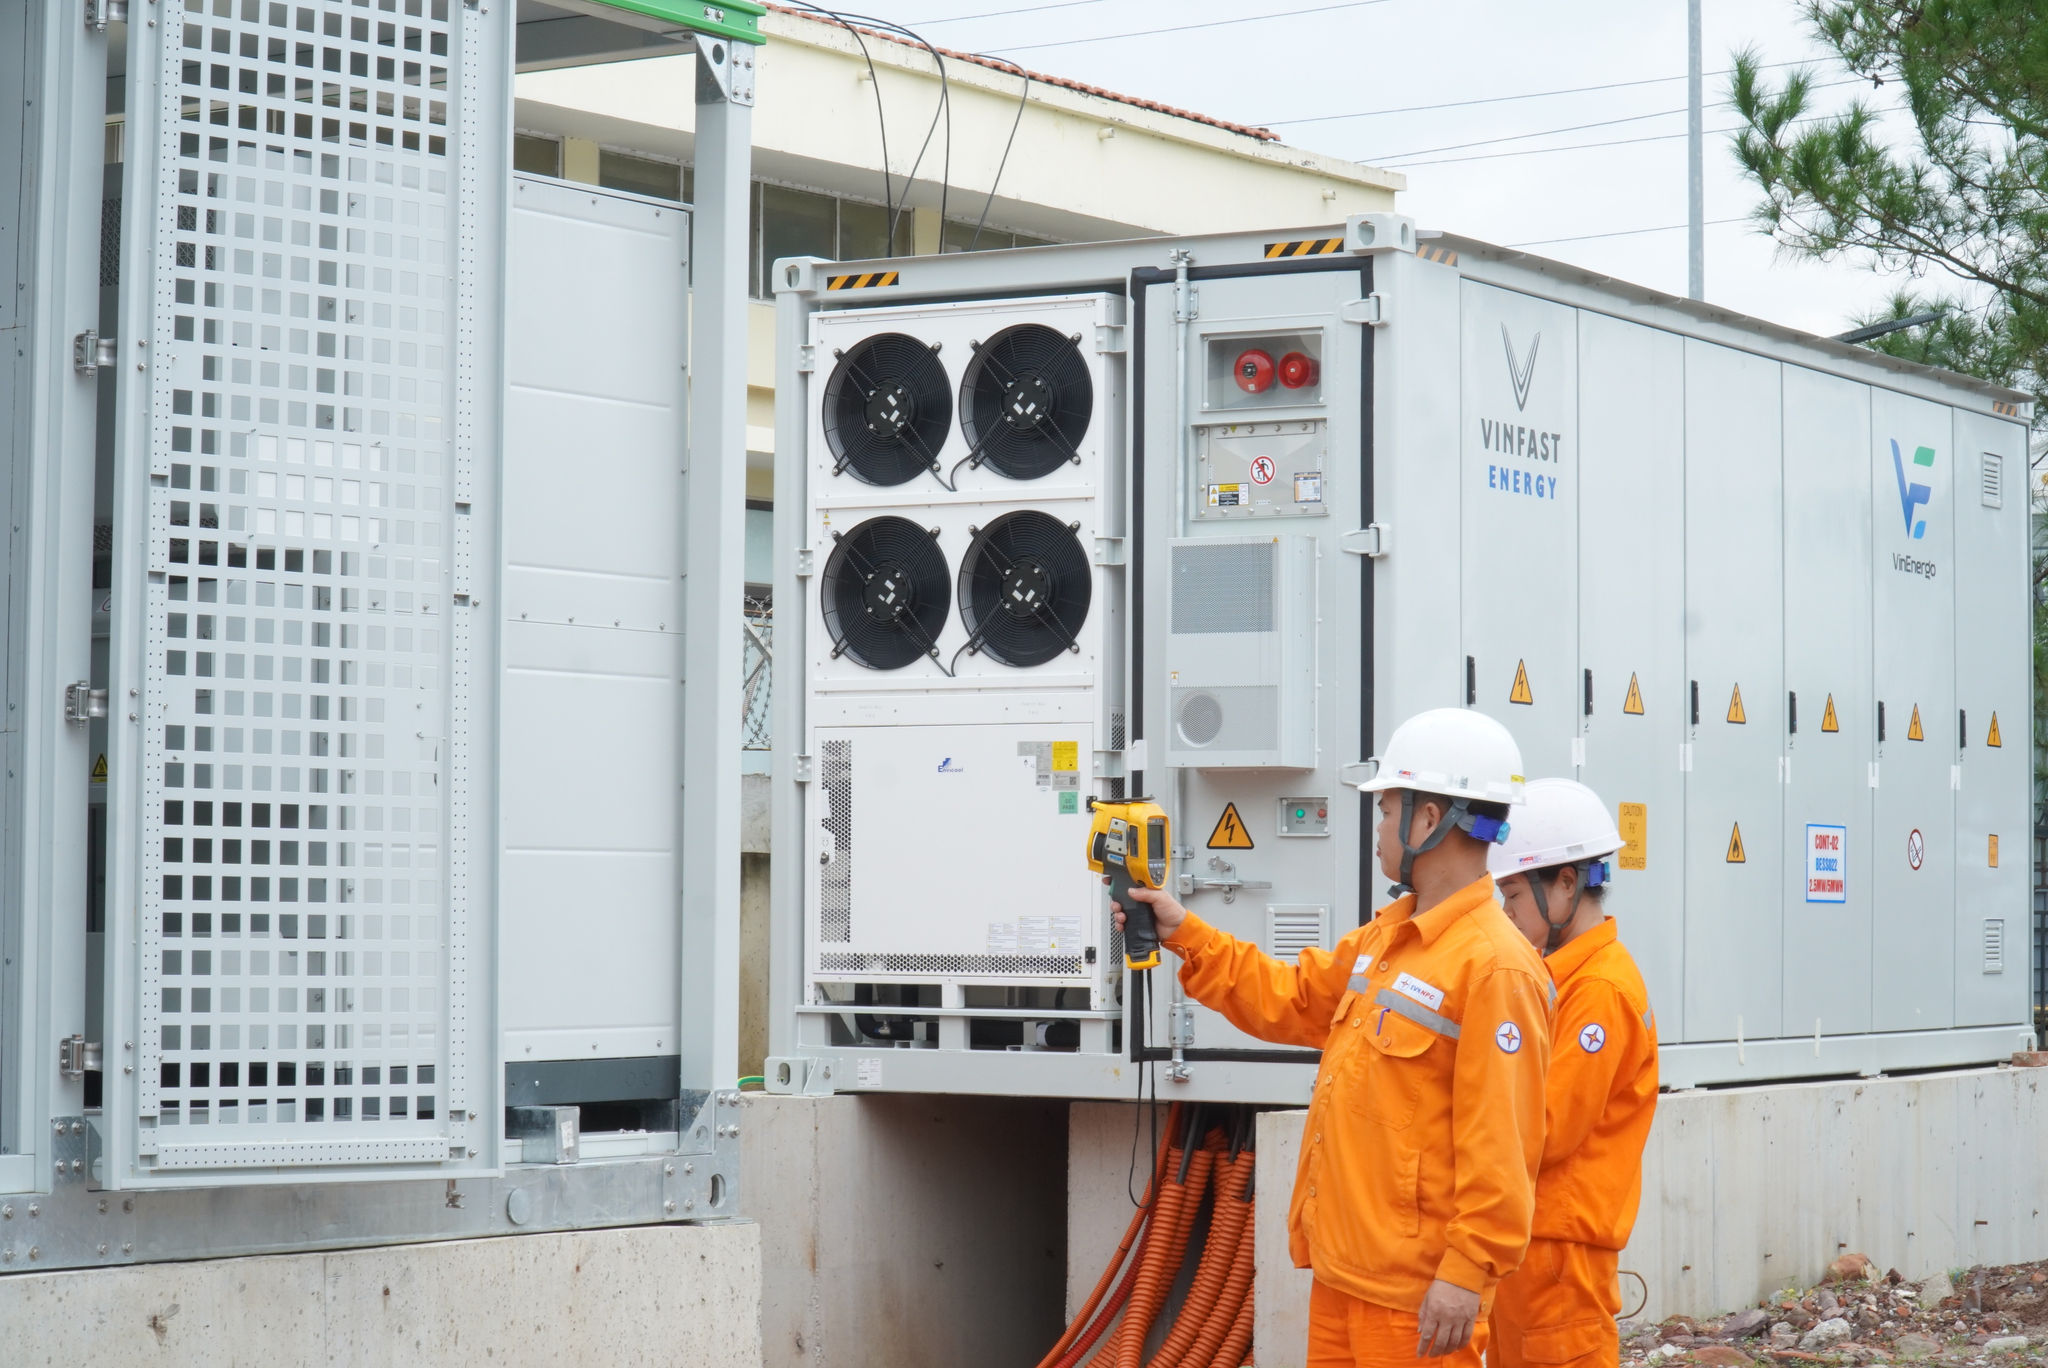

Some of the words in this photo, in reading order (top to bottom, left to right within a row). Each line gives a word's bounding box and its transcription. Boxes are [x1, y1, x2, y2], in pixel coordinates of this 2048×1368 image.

[1481, 418, 1561, 464] VINFAST
[1489, 465, 1557, 500] ENERGY
[1892, 552, 1936, 580] VinEnergo
[1815, 834, 1839, 851] CONT-02
